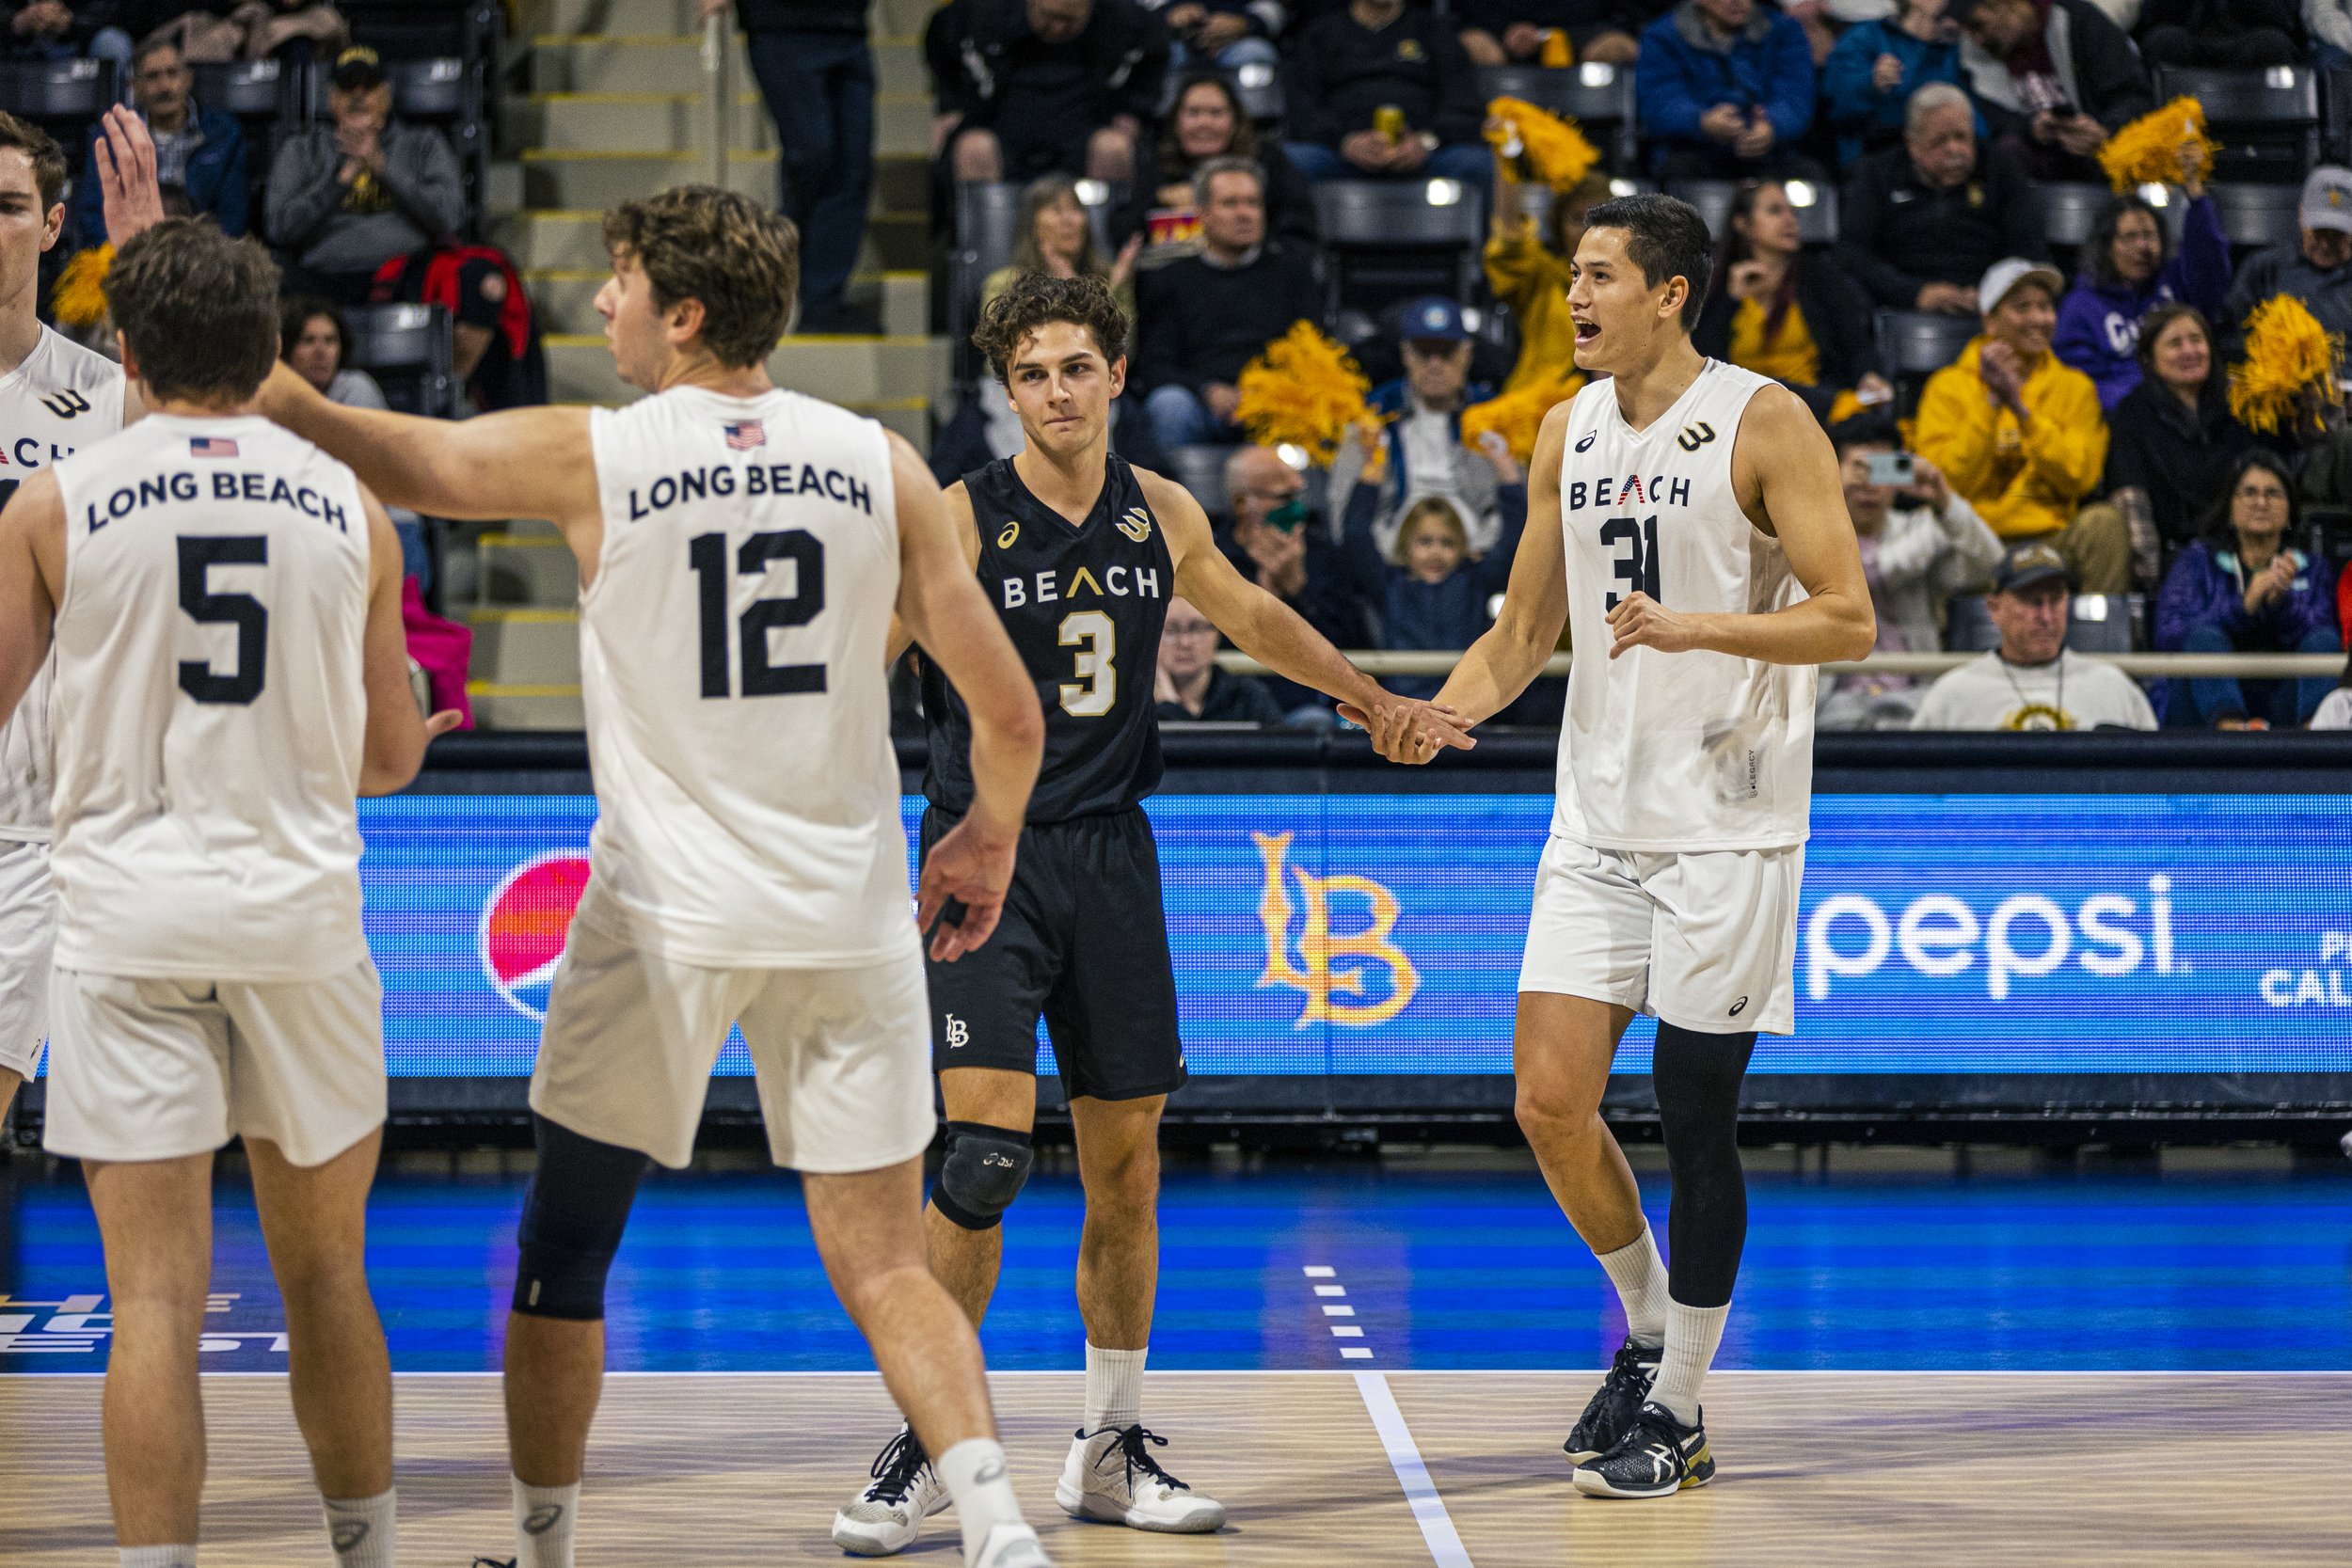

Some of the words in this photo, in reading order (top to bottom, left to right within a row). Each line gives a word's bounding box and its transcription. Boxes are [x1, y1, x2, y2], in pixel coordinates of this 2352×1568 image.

[87, 472, 199, 534] LONG
[212, 472, 348, 534] BEACH
[629, 466, 736, 522] LONG
[747, 465, 872, 515] BEACH
[1570, 474, 1691, 511] BEACH
[1003, 566, 1159, 609] BEACH
[1599, 515, 1661, 614] 31
[176, 533, 268, 706] 5
[689, 529, 827, 699] 12
[1058, 610, 1116, 717] 3
[1748, 750, 1756, 785] LEGACY
[1250, 829, 1421, 1031] LB
[1805, 874, 2172, 1001] pepsi
[2321, 930, 2352, 964] P
[2261, 970, 2352, 1007] CAL
[946, 1013, 969, 1049] LB
